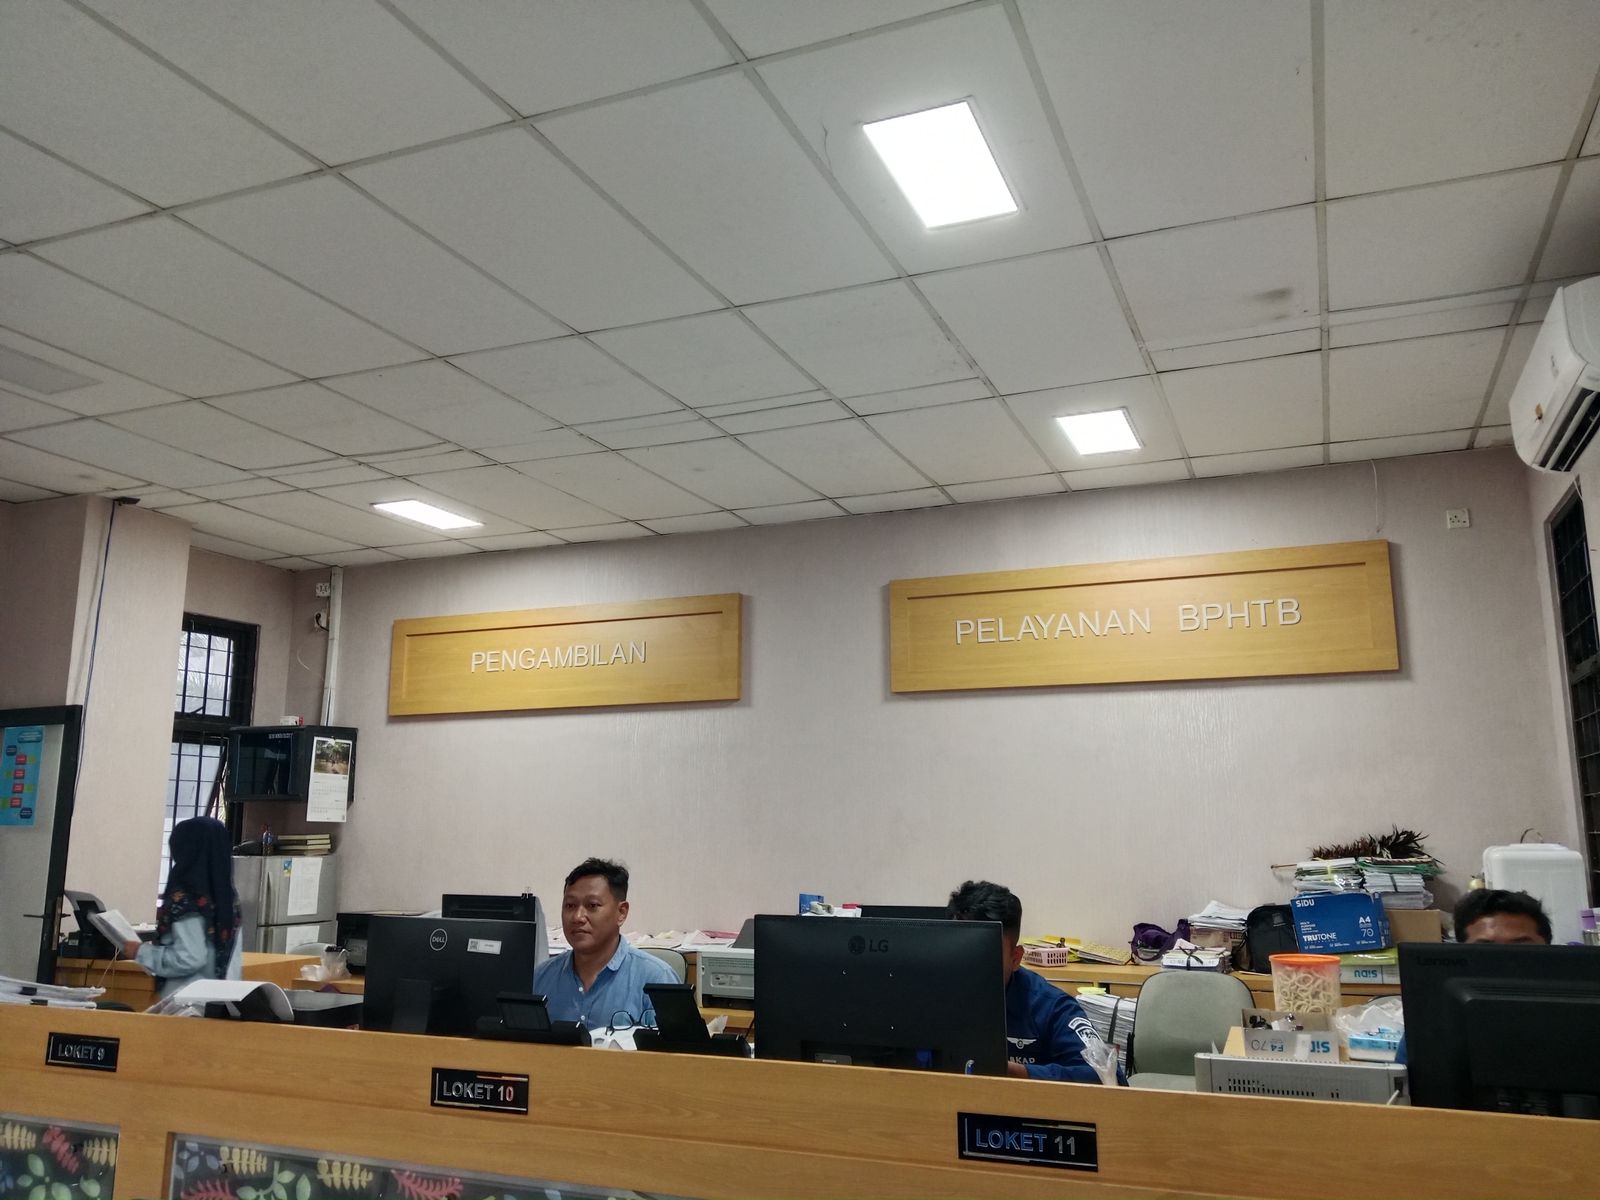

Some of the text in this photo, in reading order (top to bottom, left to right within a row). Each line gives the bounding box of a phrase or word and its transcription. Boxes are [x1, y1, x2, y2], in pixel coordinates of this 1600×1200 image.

[955, 597, 1302, 645] PELAYANAN BPHTB
[470, 640, 647, 673] PENGAMBILAN
[1358, 916, 1371, 924] A4
[869, 938, 889, 954] LG
[1302, 932, 1337, 942] TRUTONE
[58, 1043, 105, 1062] LOKET 9
[442, 1080, 514, 1102] LOKET 10
[975, 1128, 1076, 1155] LOKET 11
